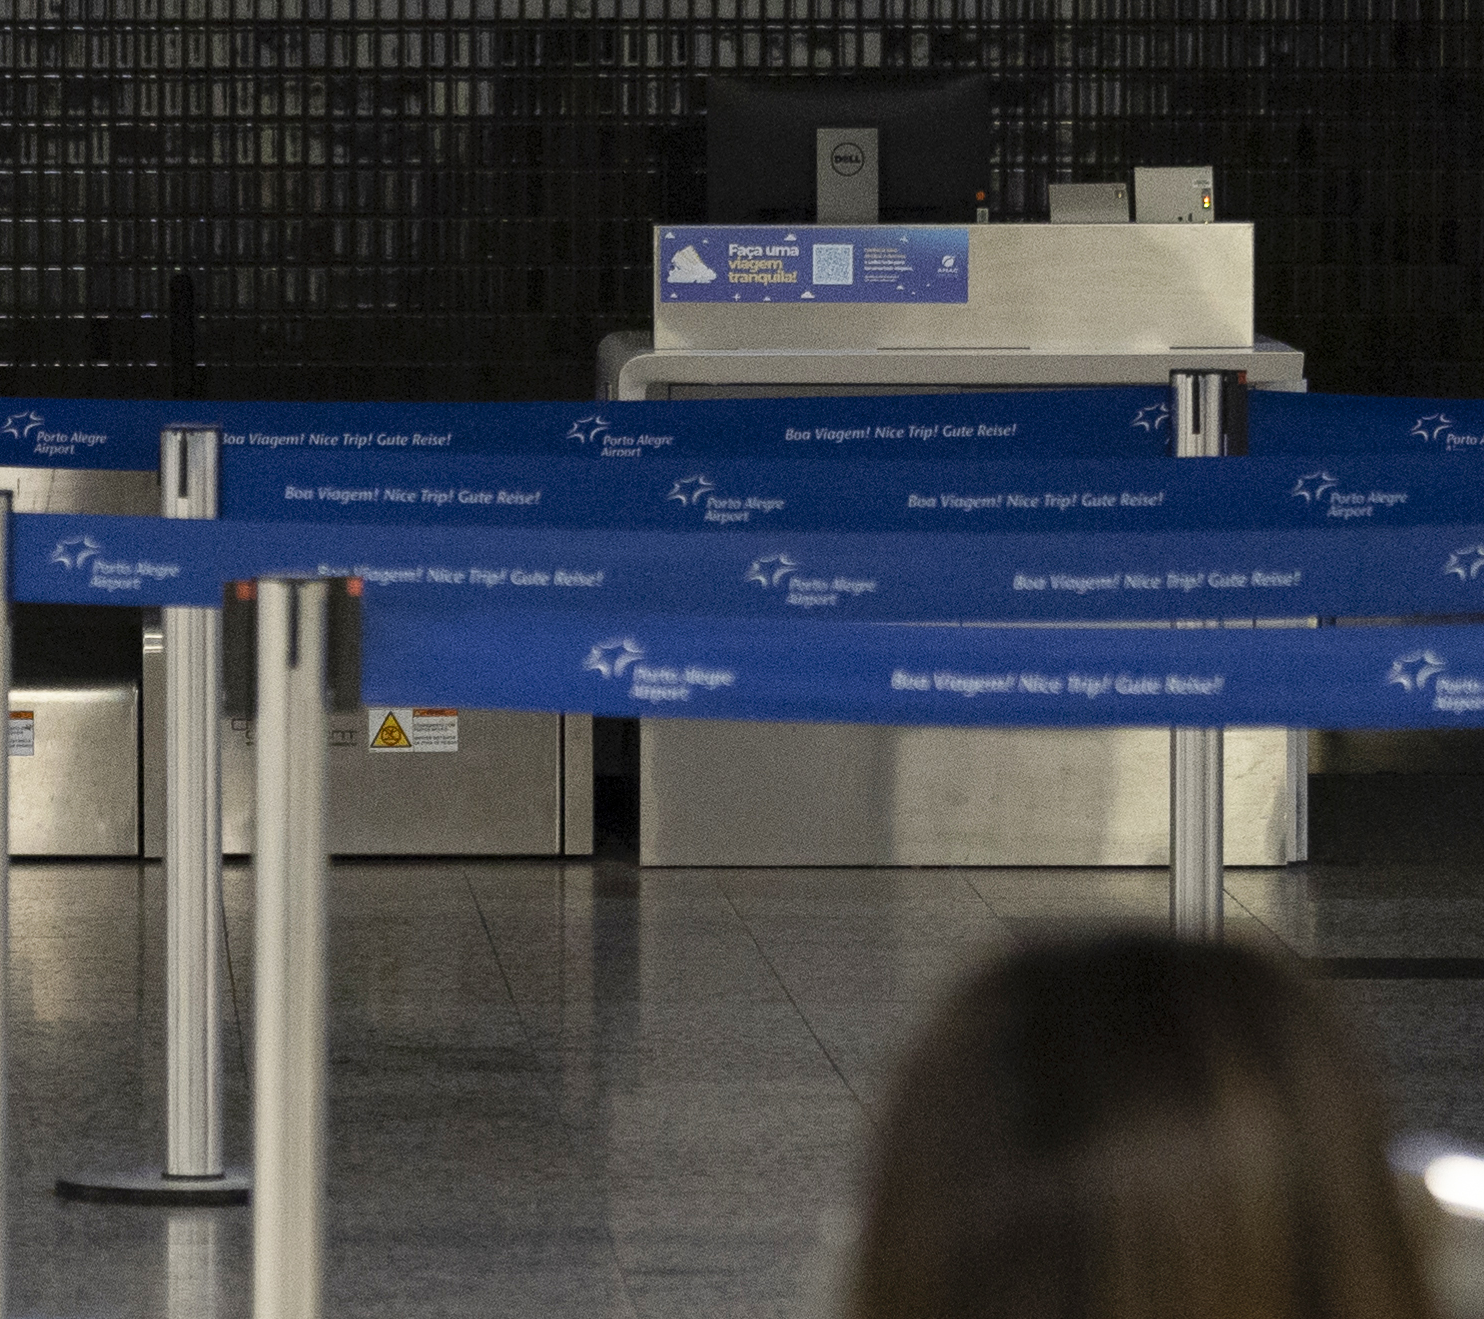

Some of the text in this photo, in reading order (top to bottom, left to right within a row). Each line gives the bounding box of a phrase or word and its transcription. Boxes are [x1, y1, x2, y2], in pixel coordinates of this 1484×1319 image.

[729, 244, 799, 259] Faça uma
[729, 258, 782, 272] viagem
[729, 270, 798, 285] tranquila!
[37, 431, 107, 448] Porto Alegre
[784, 423, 1018, 443] Boa Viagem! Nice Trip! Gute Reise!
[1446, 433, 1478, 447] Porto
[34, 442, 75, 455] Airport
[248, 433, 304, 449] Viagem!
[309, 433, 338, 446] Nice
[342, 433, 373, 449] Trip!
[377, 433, 408, 446] Gute
[412, 433, 452, 446] Reise!
[603, 434, 674, 449] Porto Alegre
[284, 484, 542, 506] Boa Viagem! Nice Trip! Gute Reise!
[907, 490, 1166, 512] Boa Viagem! Nice Trip! Gute Reise!
